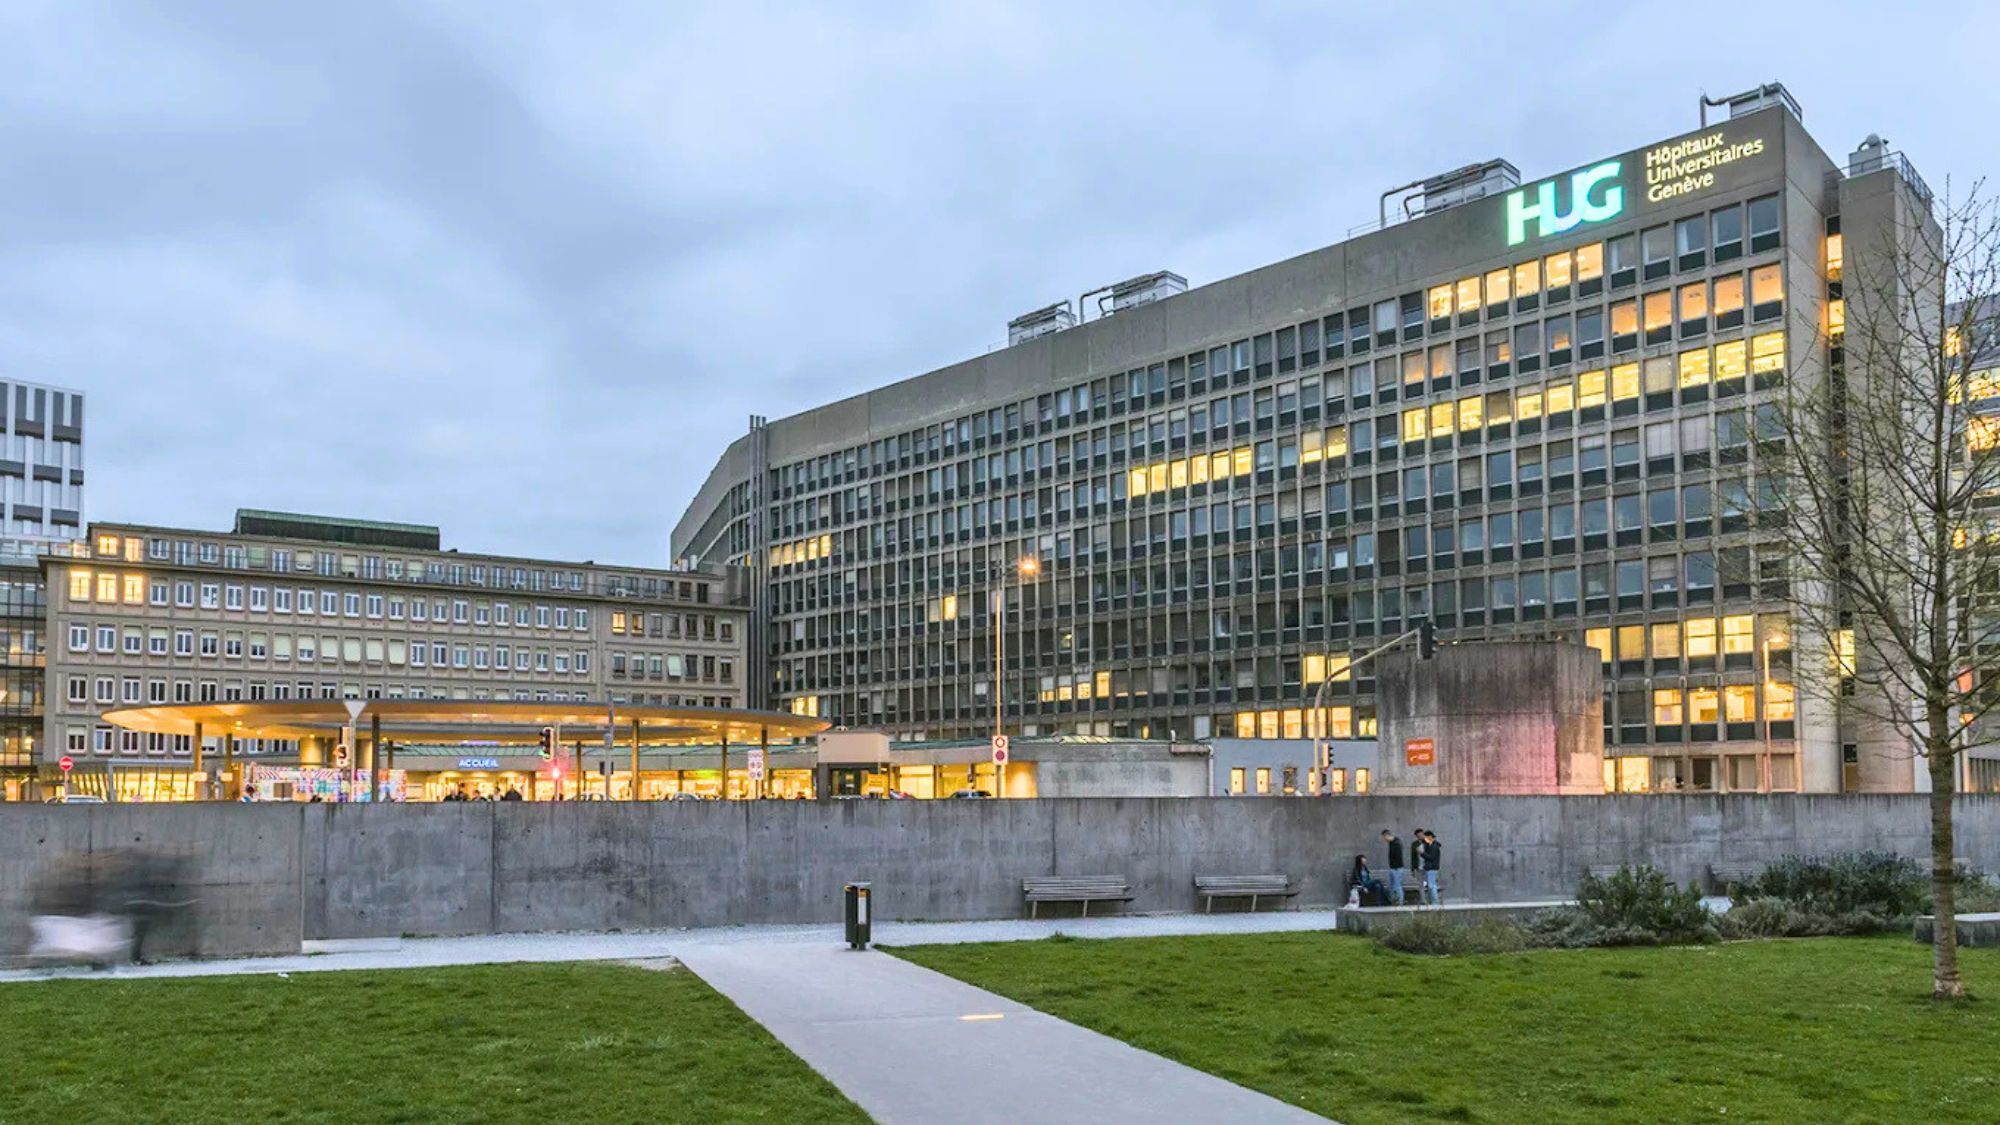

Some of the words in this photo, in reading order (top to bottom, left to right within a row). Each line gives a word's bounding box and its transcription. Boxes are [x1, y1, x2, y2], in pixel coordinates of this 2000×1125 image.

[1646, 133, 1724, 169] Hôpitaux
[1646, 138, 1764, 185] Universitaires
[1507, 161, 1623, 246] HUG
[1648, 172, 1714, 202] Genève
